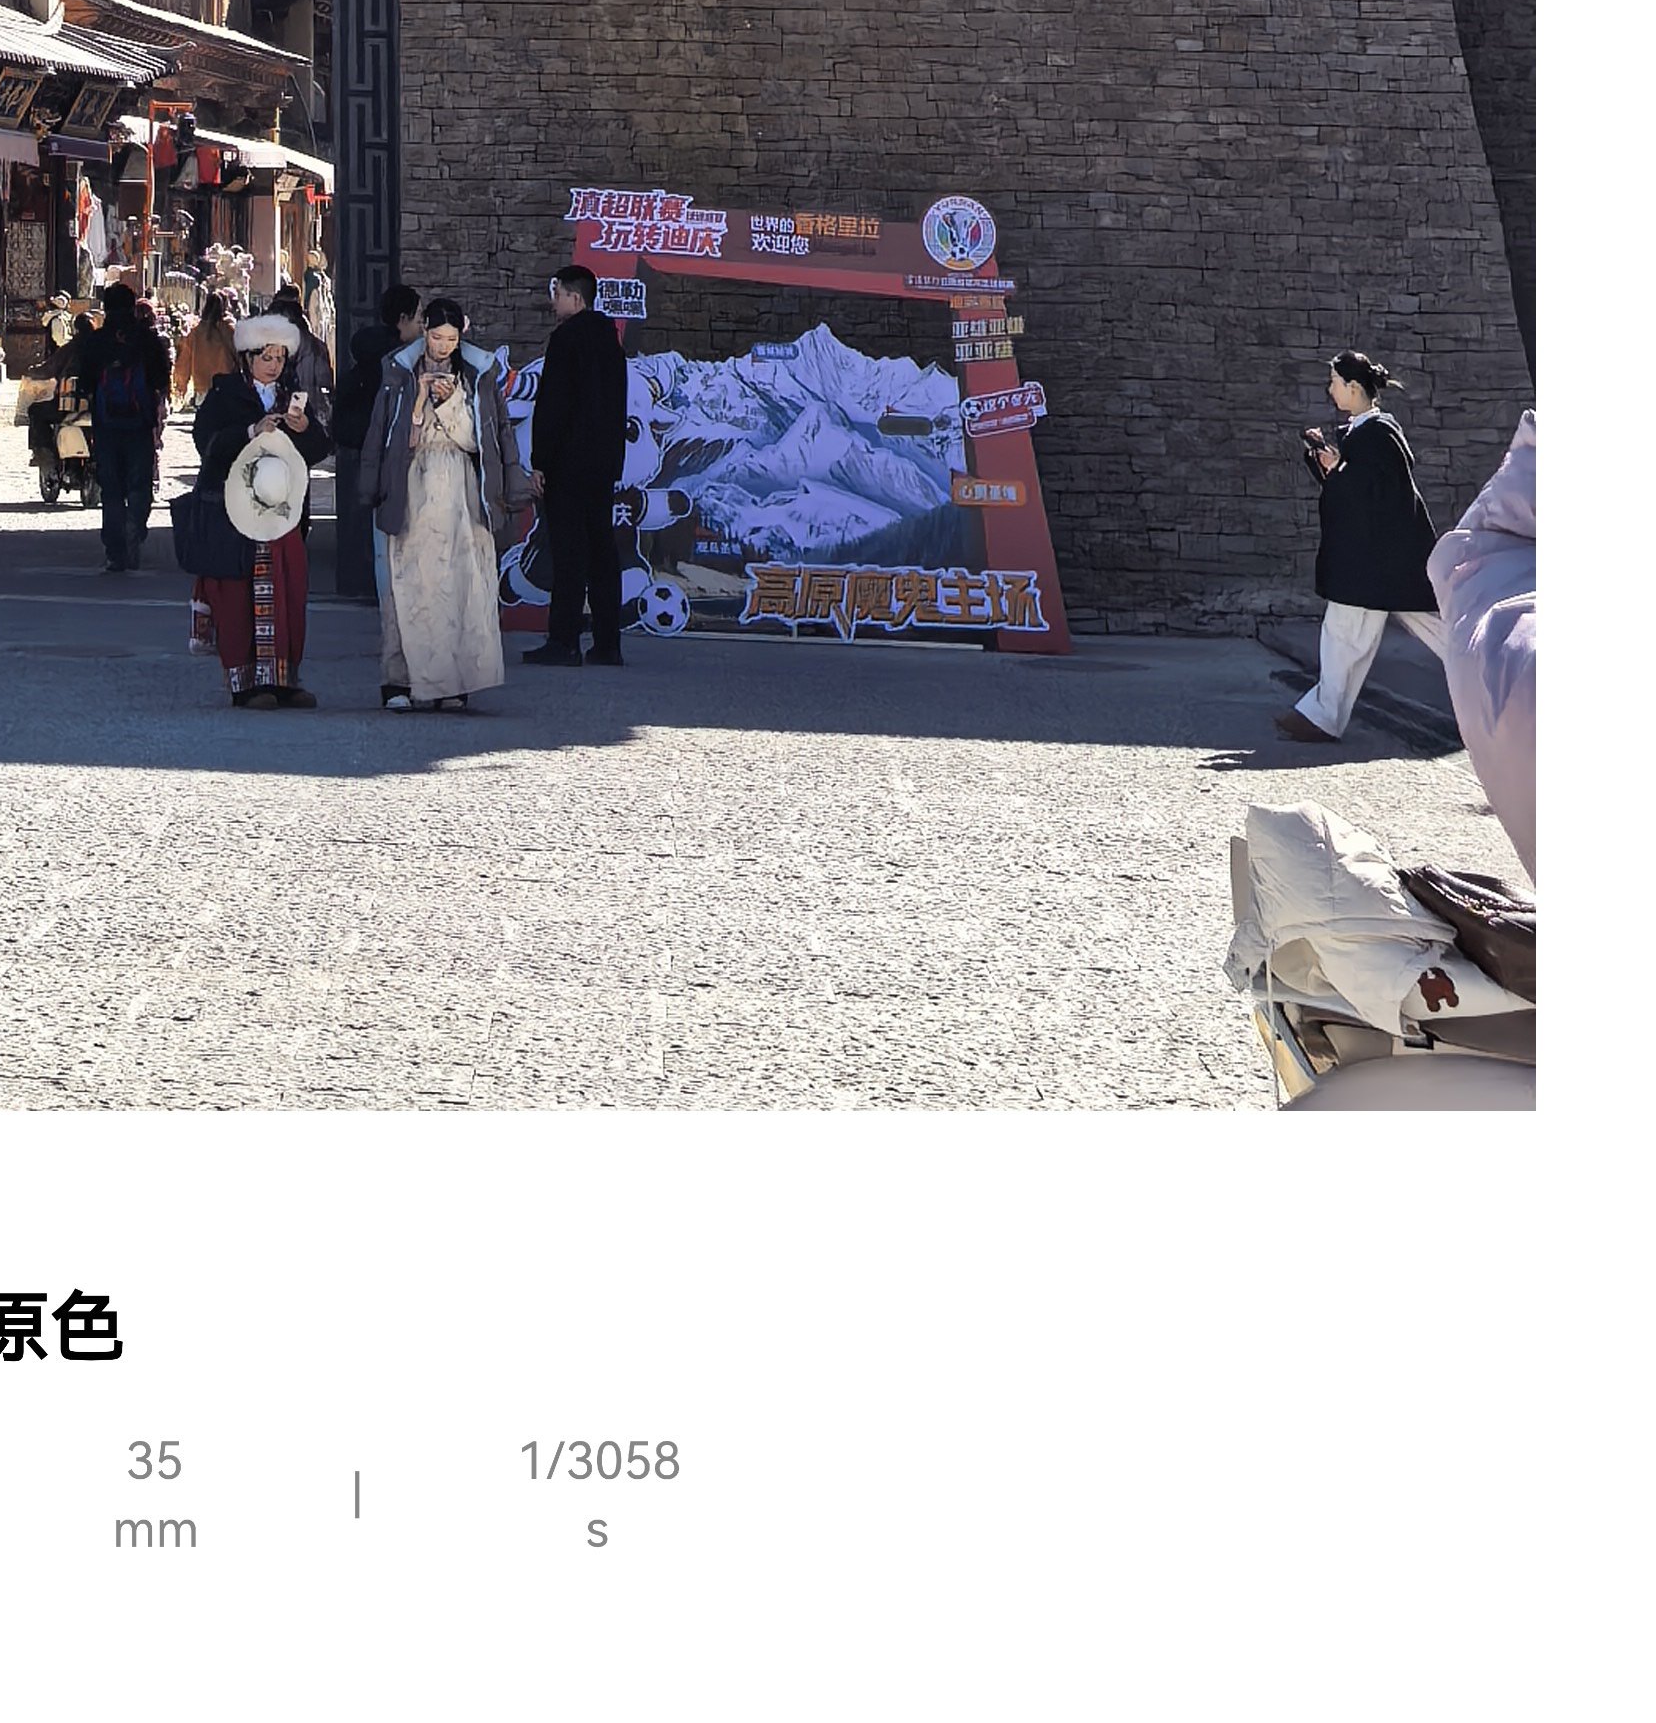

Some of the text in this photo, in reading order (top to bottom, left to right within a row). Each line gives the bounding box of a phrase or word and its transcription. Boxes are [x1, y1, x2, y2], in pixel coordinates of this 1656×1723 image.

[568, 189, 689, 223] 滇超联赛
[596, 222, 724, 255] 玩转迪庆
[751, 233, 811, 255] 欢迎您
[612, 502, 633, 527] 庆
[747, 566, 1046, 633] 高原魔鬼主场
